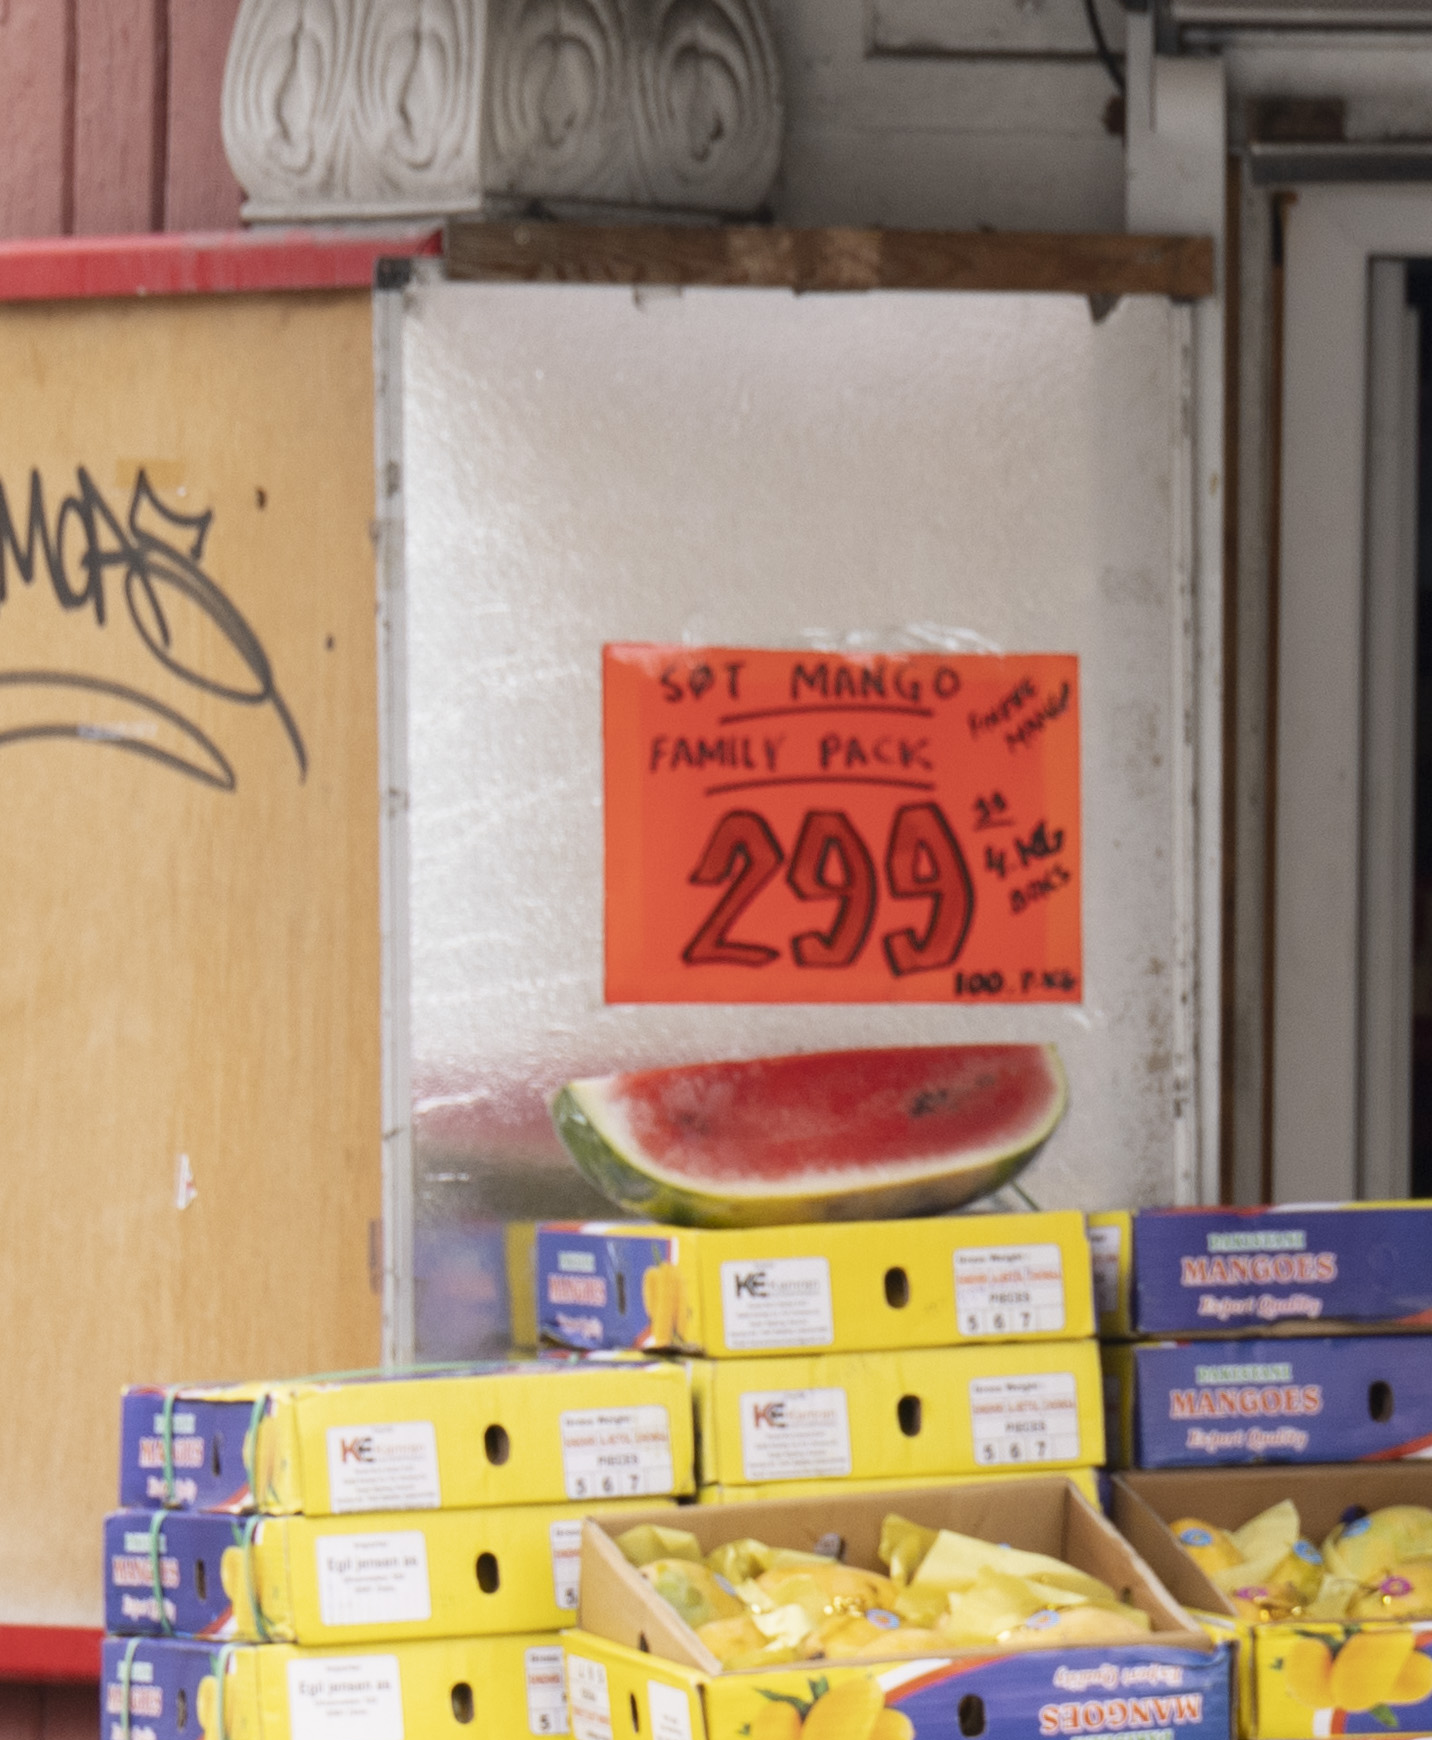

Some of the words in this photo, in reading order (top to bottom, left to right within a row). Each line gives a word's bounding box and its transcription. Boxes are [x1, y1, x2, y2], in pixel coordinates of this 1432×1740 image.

[661, 661, 745, 703] SØT
[789, 663, 959, 701] MANGO
[650, 735, 786, 771] FAMILY
[820, 735, 934, 771] PACK
[682, 802, 977, 978] 299
[1181, 1253, 1338, 1286] MANGOES
[1199, 1295, 1256, 1318] Export
[1258, 1295, 1322, 1320] Quality
[1170, 1386, 1322, 1419] MANGOES
[1186, 1428, 1243, 1451] Export
[1244, 1428, 1308, 1452] Quality
[1052, 1665, 1118, 1690] Quality
[1120, 1665, 1183, 1688] Export
[1038, 1693, 1202, 1734] MANGOES
